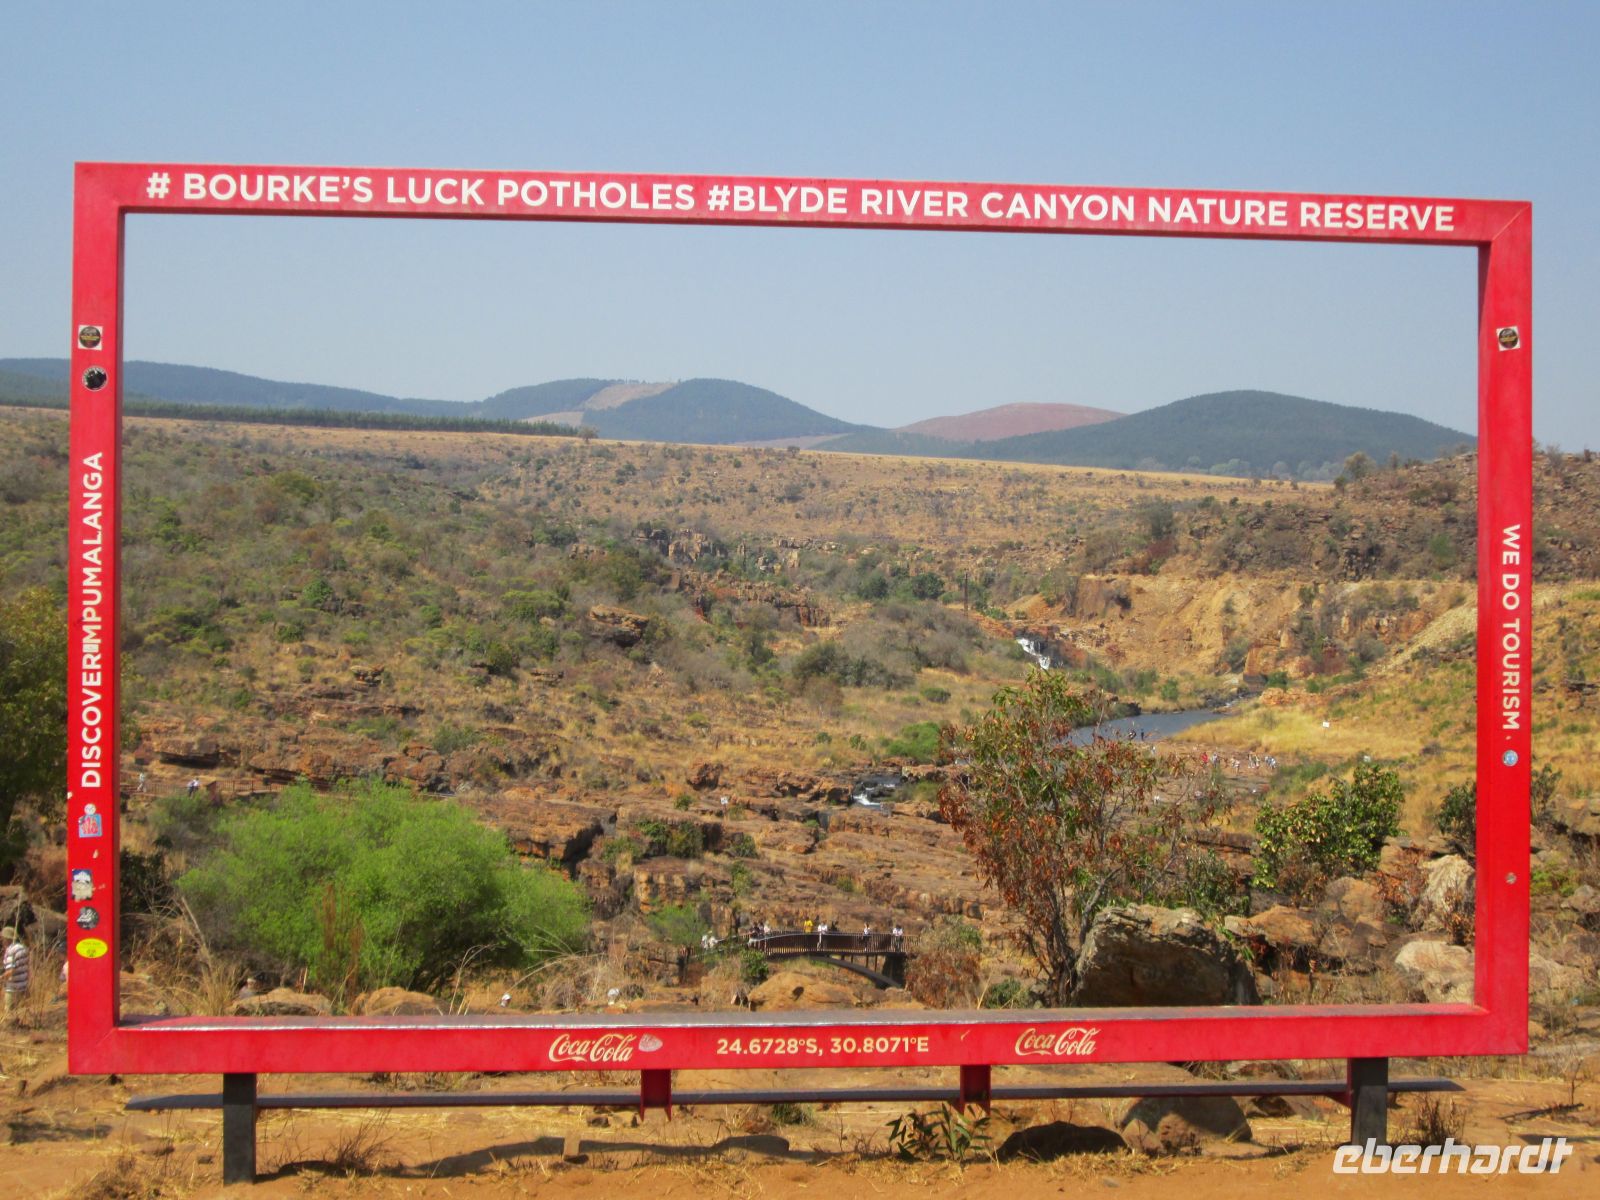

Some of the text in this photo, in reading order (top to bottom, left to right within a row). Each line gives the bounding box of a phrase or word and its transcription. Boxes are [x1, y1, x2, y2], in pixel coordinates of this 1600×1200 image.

[183, 172, 374, 204] BOURKE'S
[386, 176, 485, 206] LUCK
[497, 178, 696, 211] POTHOLES
[706, 184, 848, 215] #BLYDE
[860, 188, 969, 218] RIVER
[980, 191, 1135, 222] CANYON
[1148, 196, 1288, 227] NATURE
[1300, 201, 1454, 232] RESERVE
[81, 451, 103, 788] DISCOVER MPUMALANGA
[1502, 524, 1521, 730] WE DO TOURISM
[830, 1036, 929, 1054] 30.8071°E
